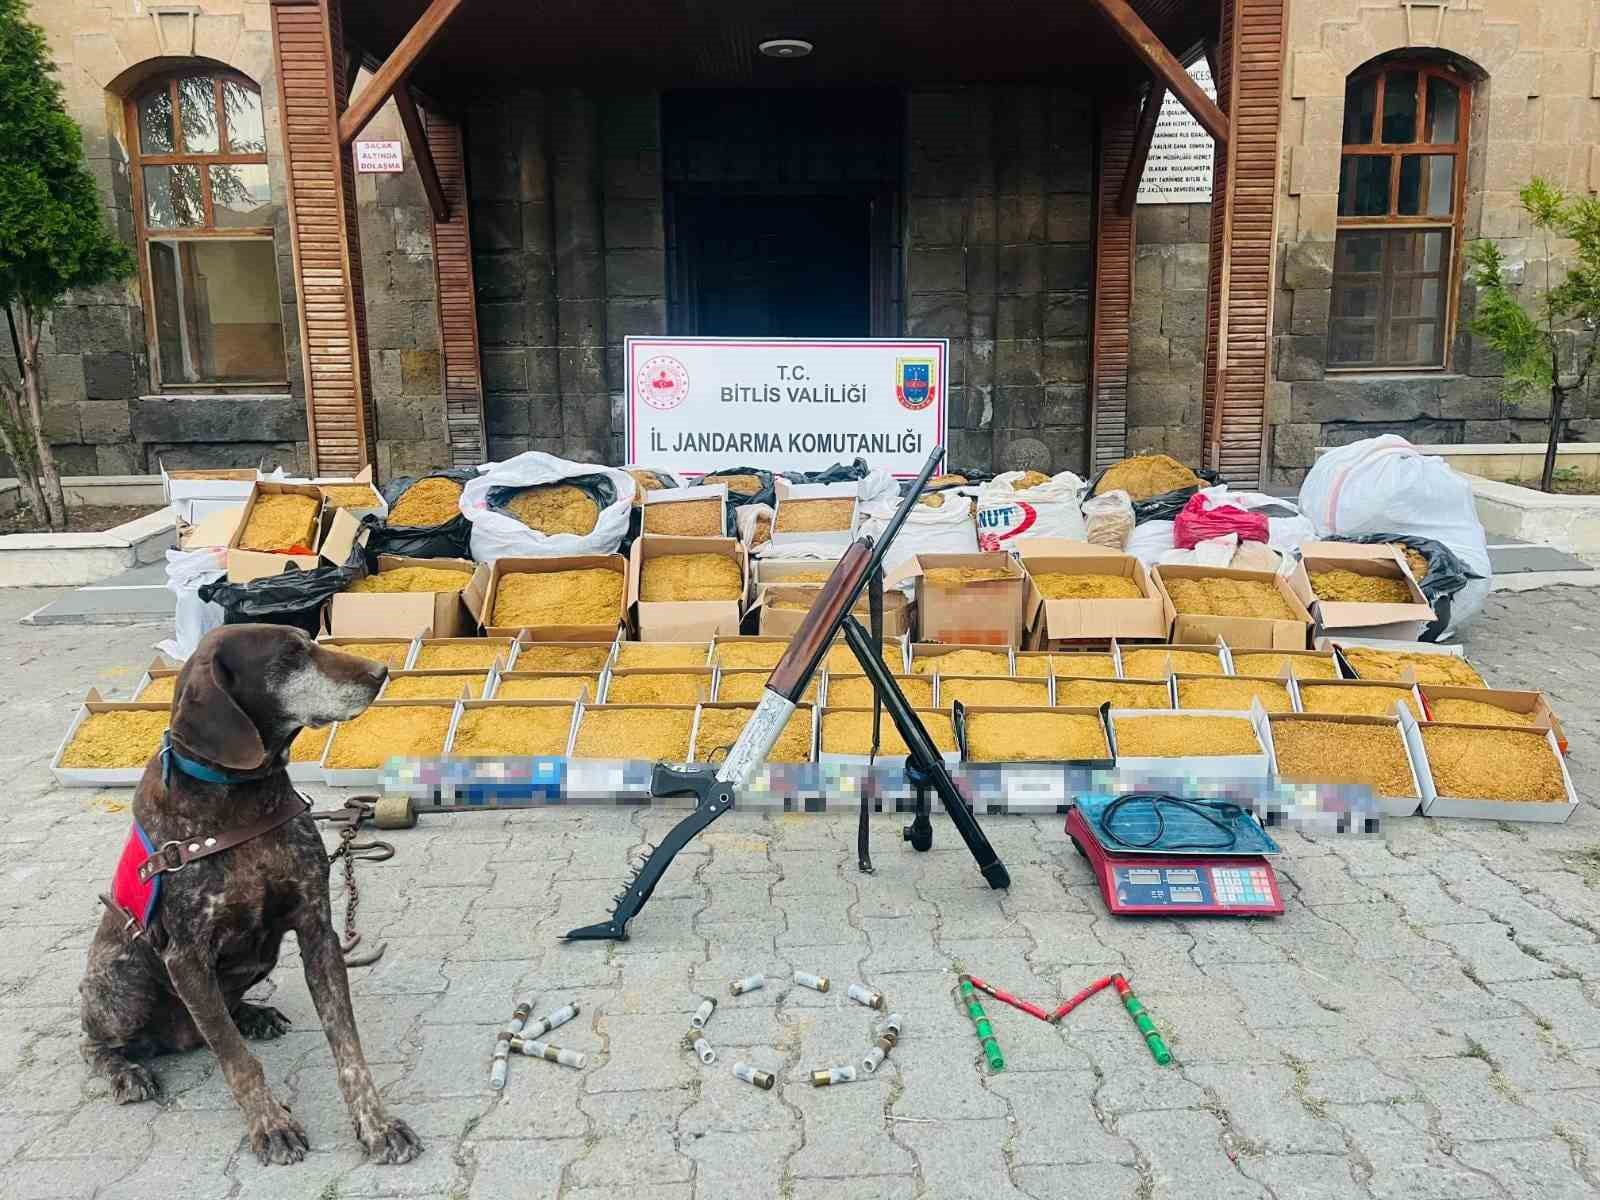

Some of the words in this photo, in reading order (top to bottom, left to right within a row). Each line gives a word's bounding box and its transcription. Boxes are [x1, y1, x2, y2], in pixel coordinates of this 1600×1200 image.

[776, 365, 810, 381] T.C.
[720, 384, 781, 403] BİTLİS
[786, 383, 866, 403] VALİLİĞİ
[651, 427, 668, 452] İL
[672, 431, 784, 453] JANDARMA
[788, 428, 922, 454] KOMUTANLIĞI
